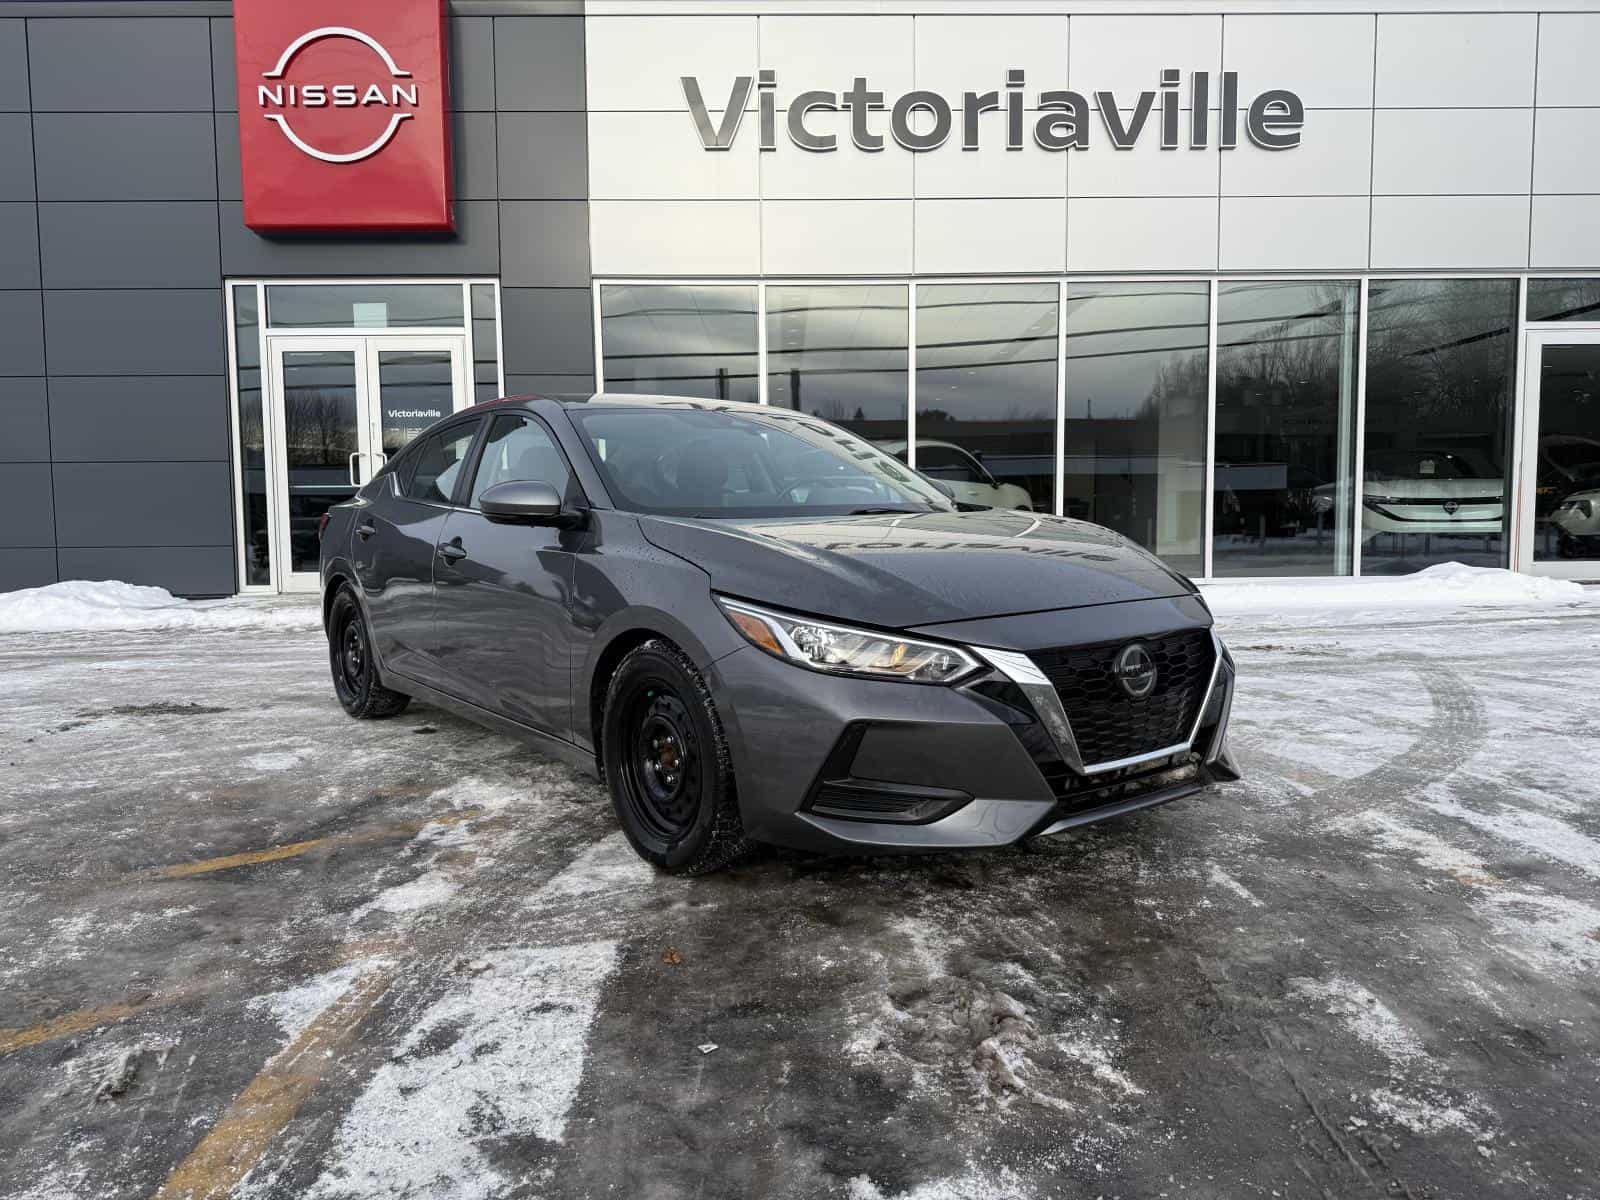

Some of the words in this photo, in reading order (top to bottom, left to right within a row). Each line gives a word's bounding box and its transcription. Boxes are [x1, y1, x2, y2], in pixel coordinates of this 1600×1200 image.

[257, 84, 419, 106] NISSAN
[681, 70, 1304, 152] Victoriaville
[387, 409, 441, 418] Victoriaville
